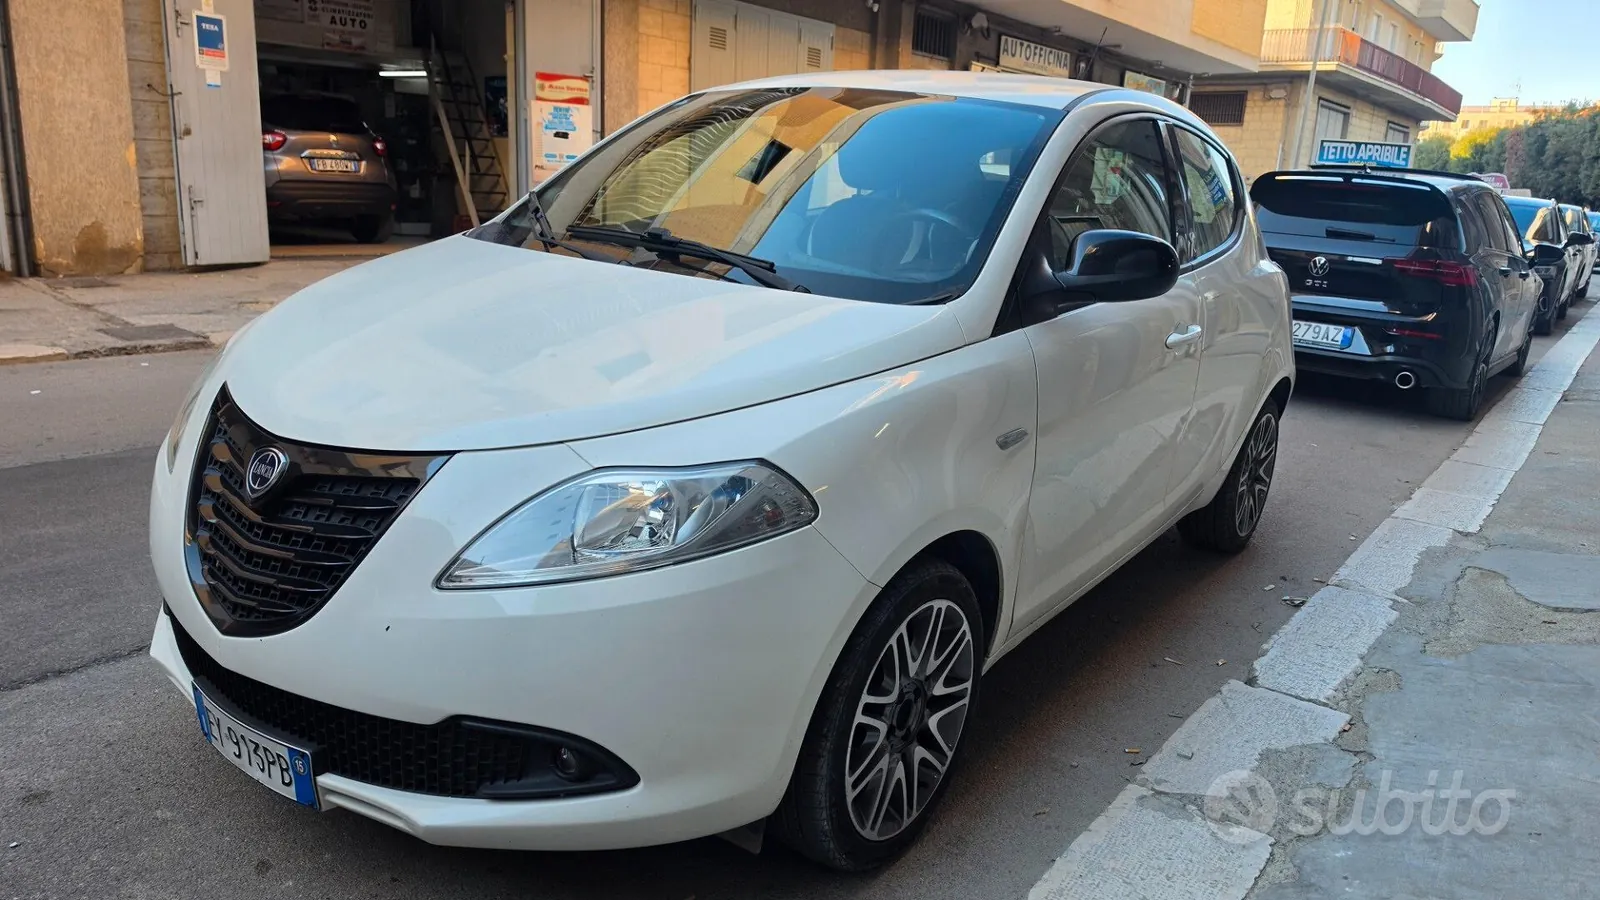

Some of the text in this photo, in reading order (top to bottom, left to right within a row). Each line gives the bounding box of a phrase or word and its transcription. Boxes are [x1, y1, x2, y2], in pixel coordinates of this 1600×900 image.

[329, 15, 368, 29] AUTO
[1002, 37, 1068, 70] AUTOFFICINA
[1323, 141, 1408, 166] TETTO APRIBILE
[1293, 322, 1343, 343] 279AZ
[227, 726, 293, 788] 913PB
[295, 760, 304, 773] 15
